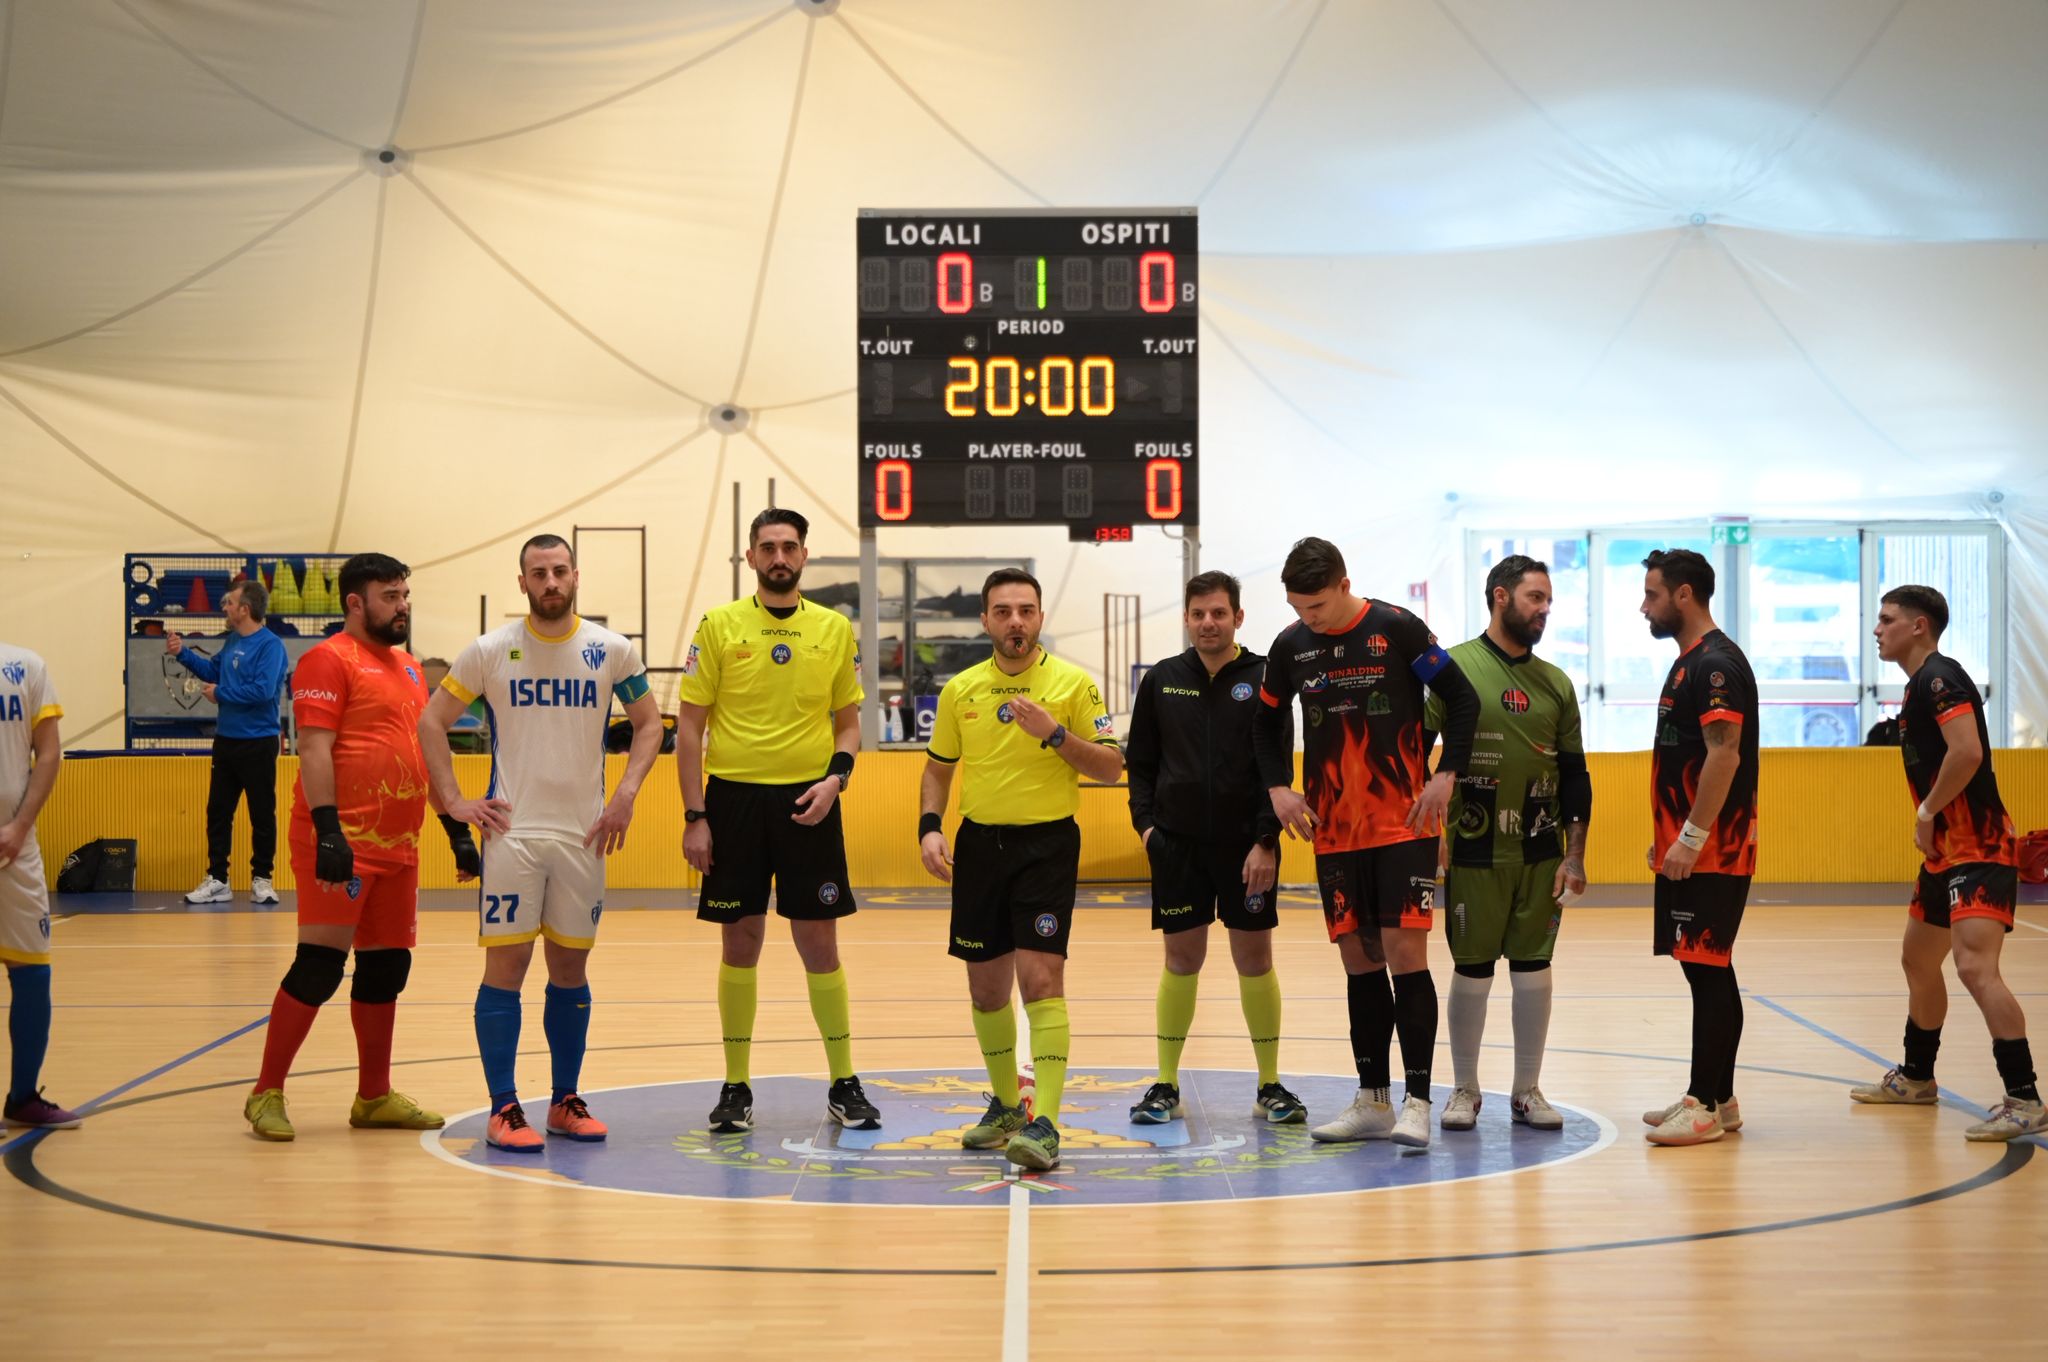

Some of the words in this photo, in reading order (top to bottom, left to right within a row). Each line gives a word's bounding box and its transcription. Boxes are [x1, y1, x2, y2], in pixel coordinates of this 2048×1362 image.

[885, 224, 981, 246] LOCALI
[1081, 223, 1171, 245] OSPITI
[937, 252, 973, 314] 0
[1036, 256, 1046, 311] 1
[1139, 252, 1175, 313] 0
[980, 284, 993, 303] B
[1182, 284, 1196, 302] B
[997, 320, 1065, 335] PERIOD
[860, 340, 914, 355] T.OUT
[1143, 339, 1197, 354] T.OUT
[944, 357, 1115, 417] 20:00
[864, 444, 922, 459] FOULS
[968, 443, 1086, 459] PLAYER-FOUL
[1134, 442, 1193, 458] FOULS
[875, 460, 912, 521] 0
[1146, 459, 1182, 520] 0
[761, 628, 802, 639] GIVOVA
[1327, 666, 1386, 680] RINALDINO
[509, 678, 598, 708] ISCHIA
[990, 687, 1031, 696] GIVOVA
[1162, 687, 1200, 698] GIVOVA
[485, 893, 520, 924] 27
